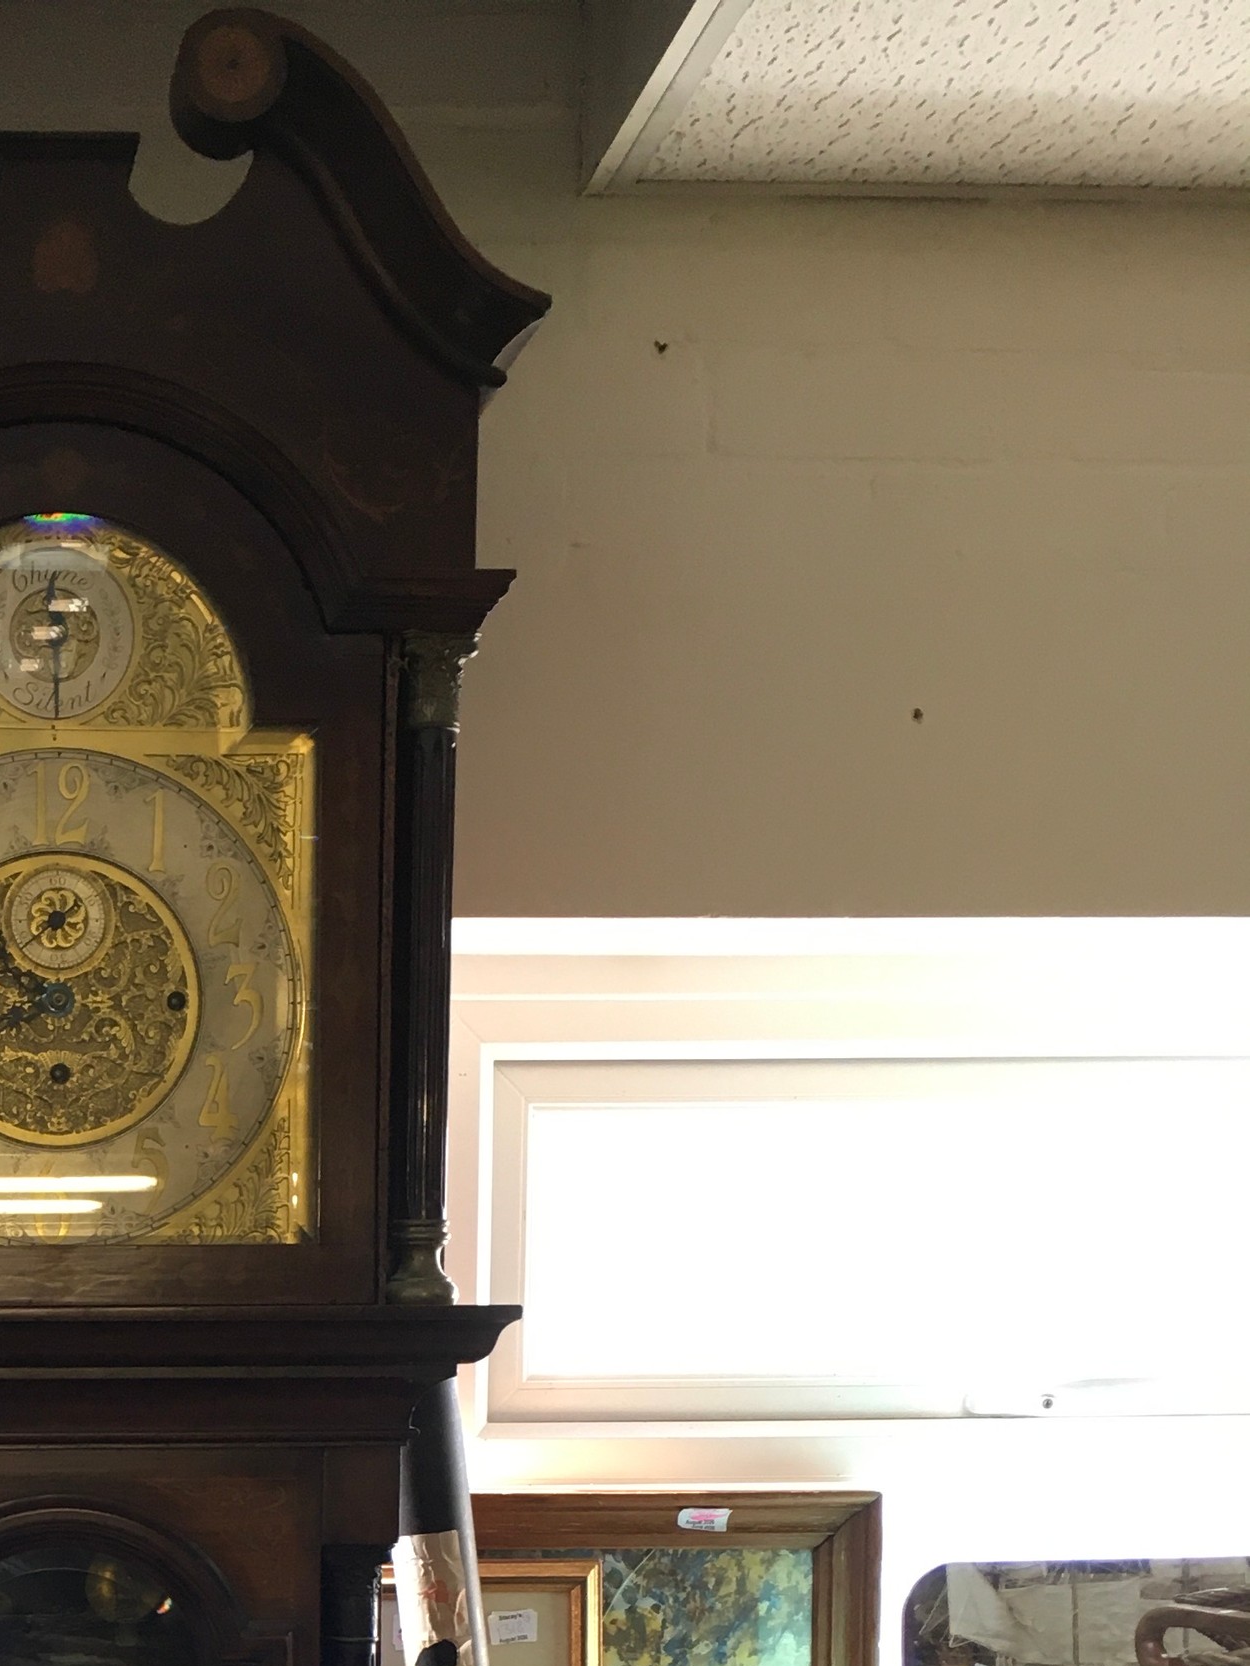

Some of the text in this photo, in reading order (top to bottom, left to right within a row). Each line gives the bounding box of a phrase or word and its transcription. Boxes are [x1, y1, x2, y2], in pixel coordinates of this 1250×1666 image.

[12, 560, 94, 592] Chime
[26, 761, 90, 847] 12
[143, 788, 167, 873] 1
[204, 857, 241, 947] 2
[223, 962, 264, 1050] 3
[199, 1053, 240, 1144] 4
[34, 1159, 72, 1245] 6
[131, 1127, 169, 1215] 5
